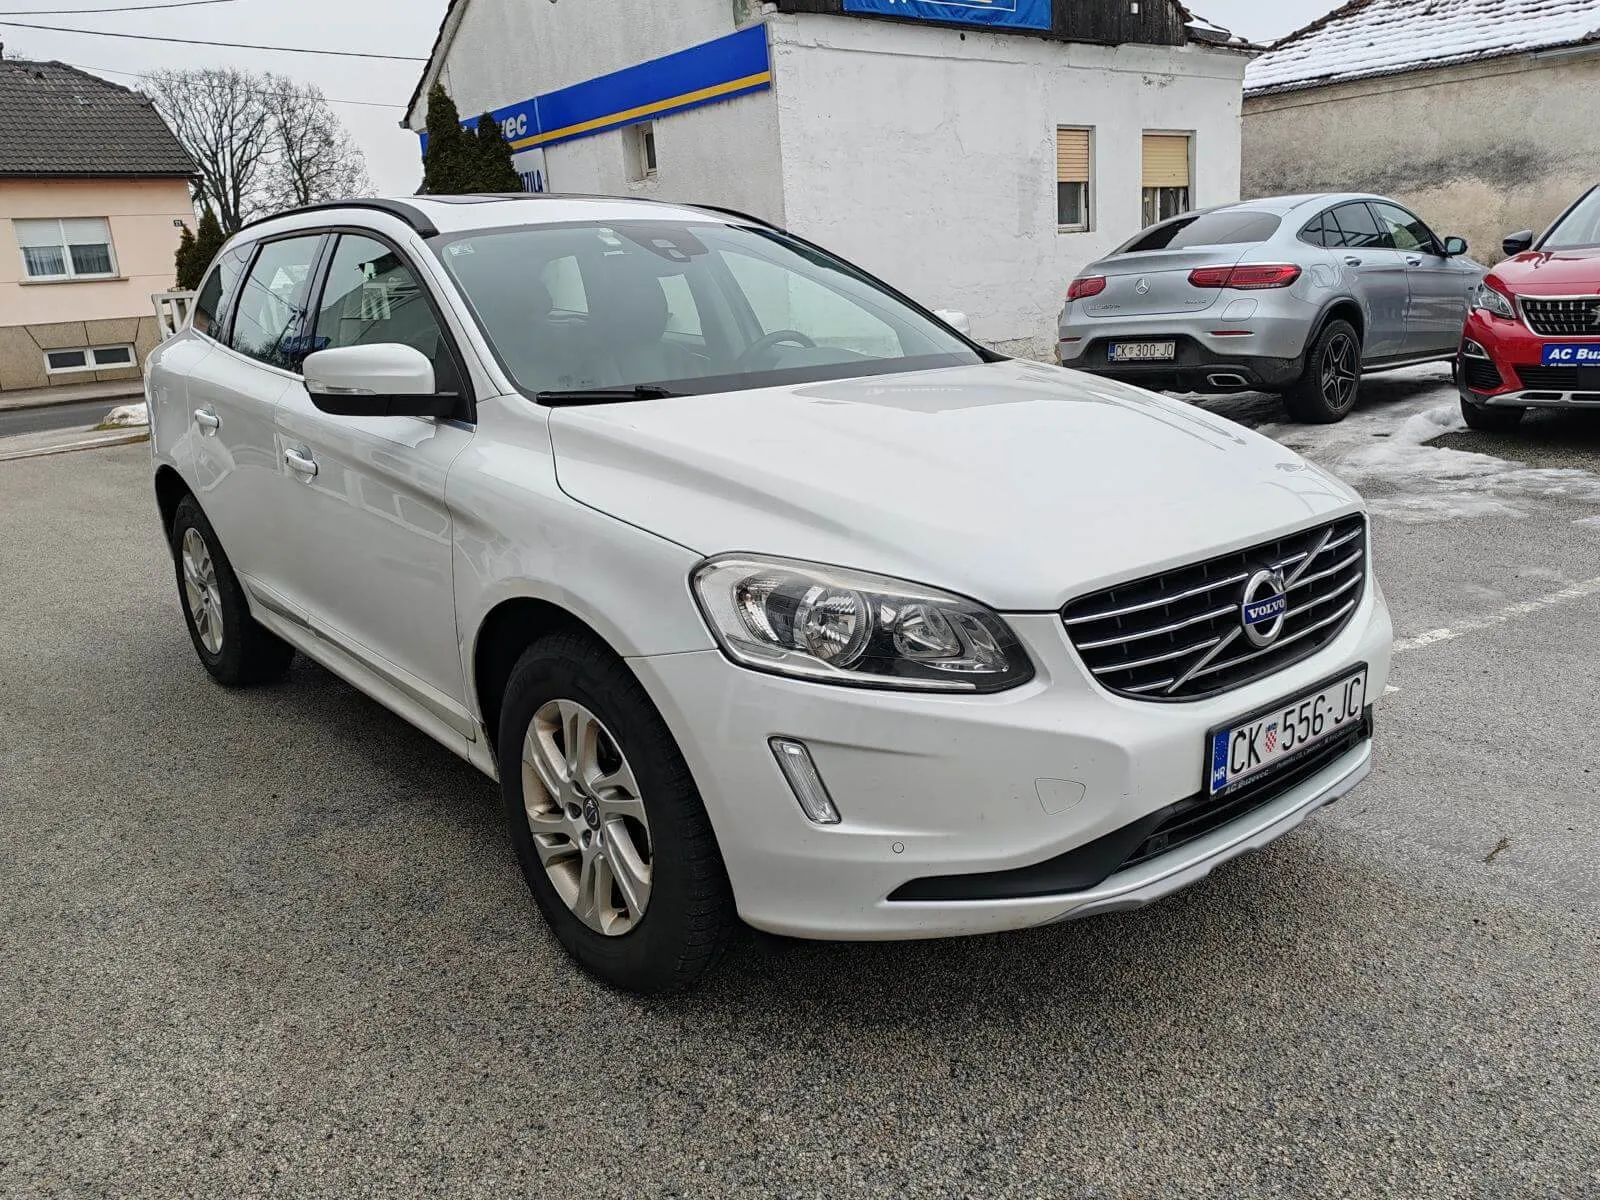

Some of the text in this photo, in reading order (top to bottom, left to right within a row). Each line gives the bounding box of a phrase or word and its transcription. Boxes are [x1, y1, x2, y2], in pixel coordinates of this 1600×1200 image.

[1116, 344, 1127, 357] CK
[1548, 348, 1573, 360] AC
[1248, 598, 1285, 619] VOLVO
[1231, 723, 1264, 774] CK
[1212, 766, 1225, 783] HR
